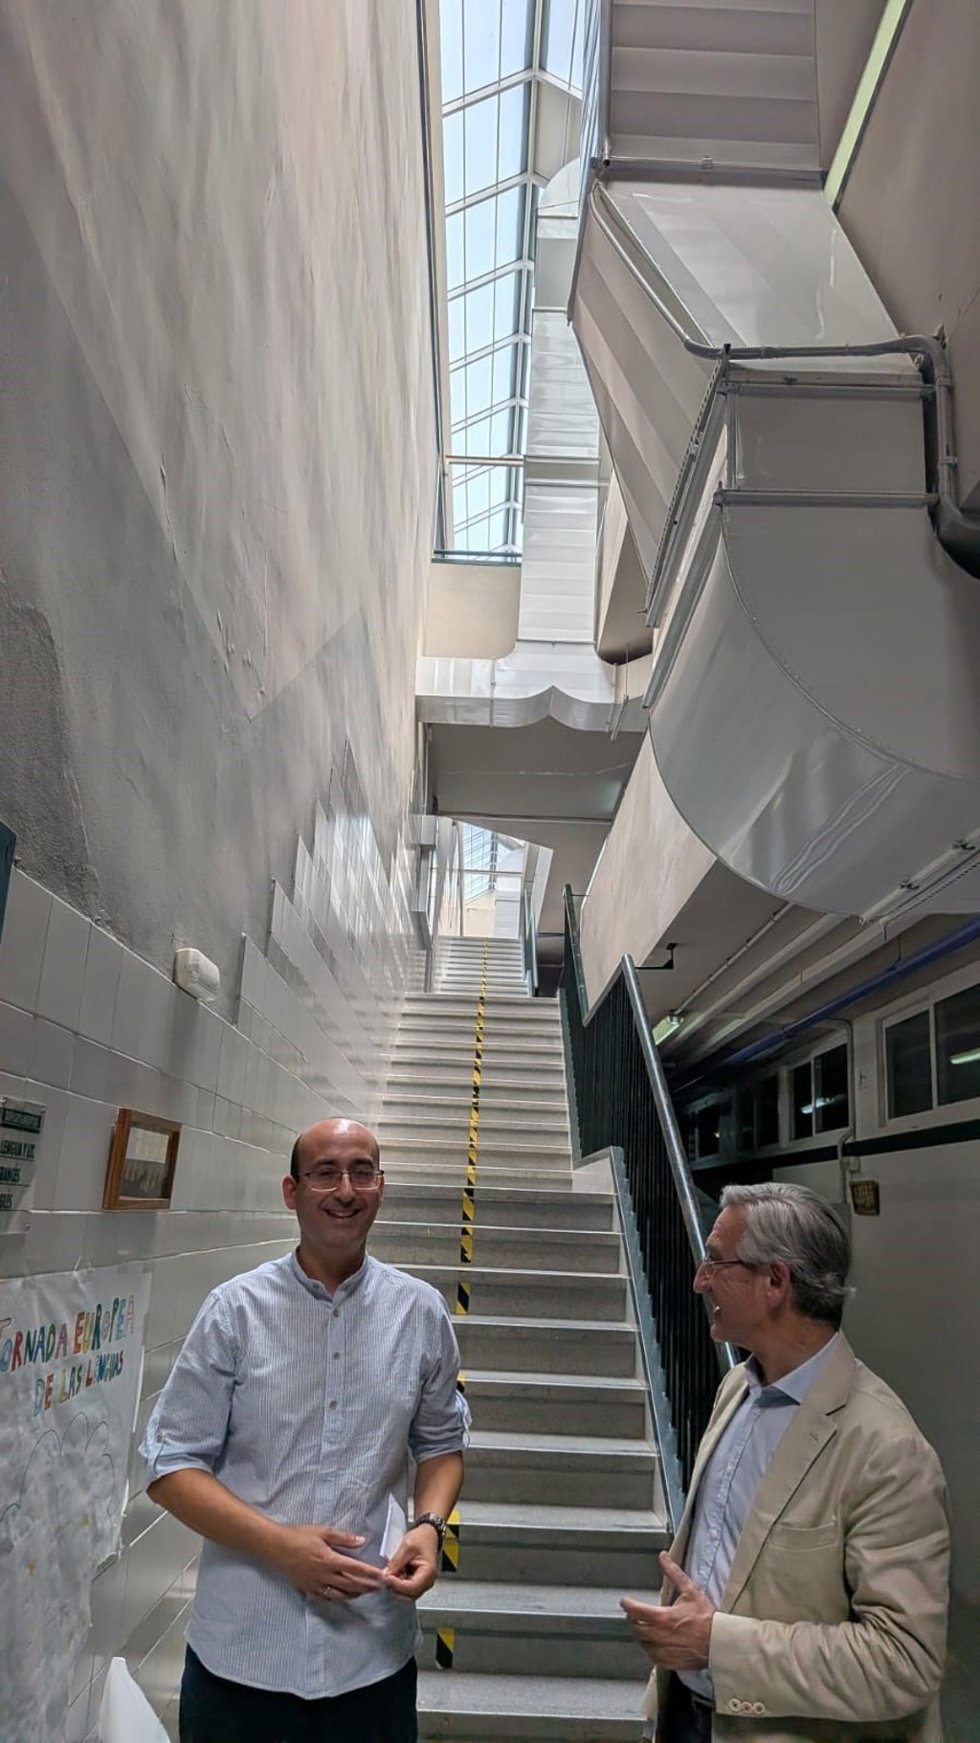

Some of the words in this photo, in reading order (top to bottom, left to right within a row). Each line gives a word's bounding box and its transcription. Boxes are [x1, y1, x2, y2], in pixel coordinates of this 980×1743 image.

[73, 1295, 135, 1354] EUROPEA
[34, 1374, 54, 1416] DE
[60, 1365, 83, 1403] LAS
